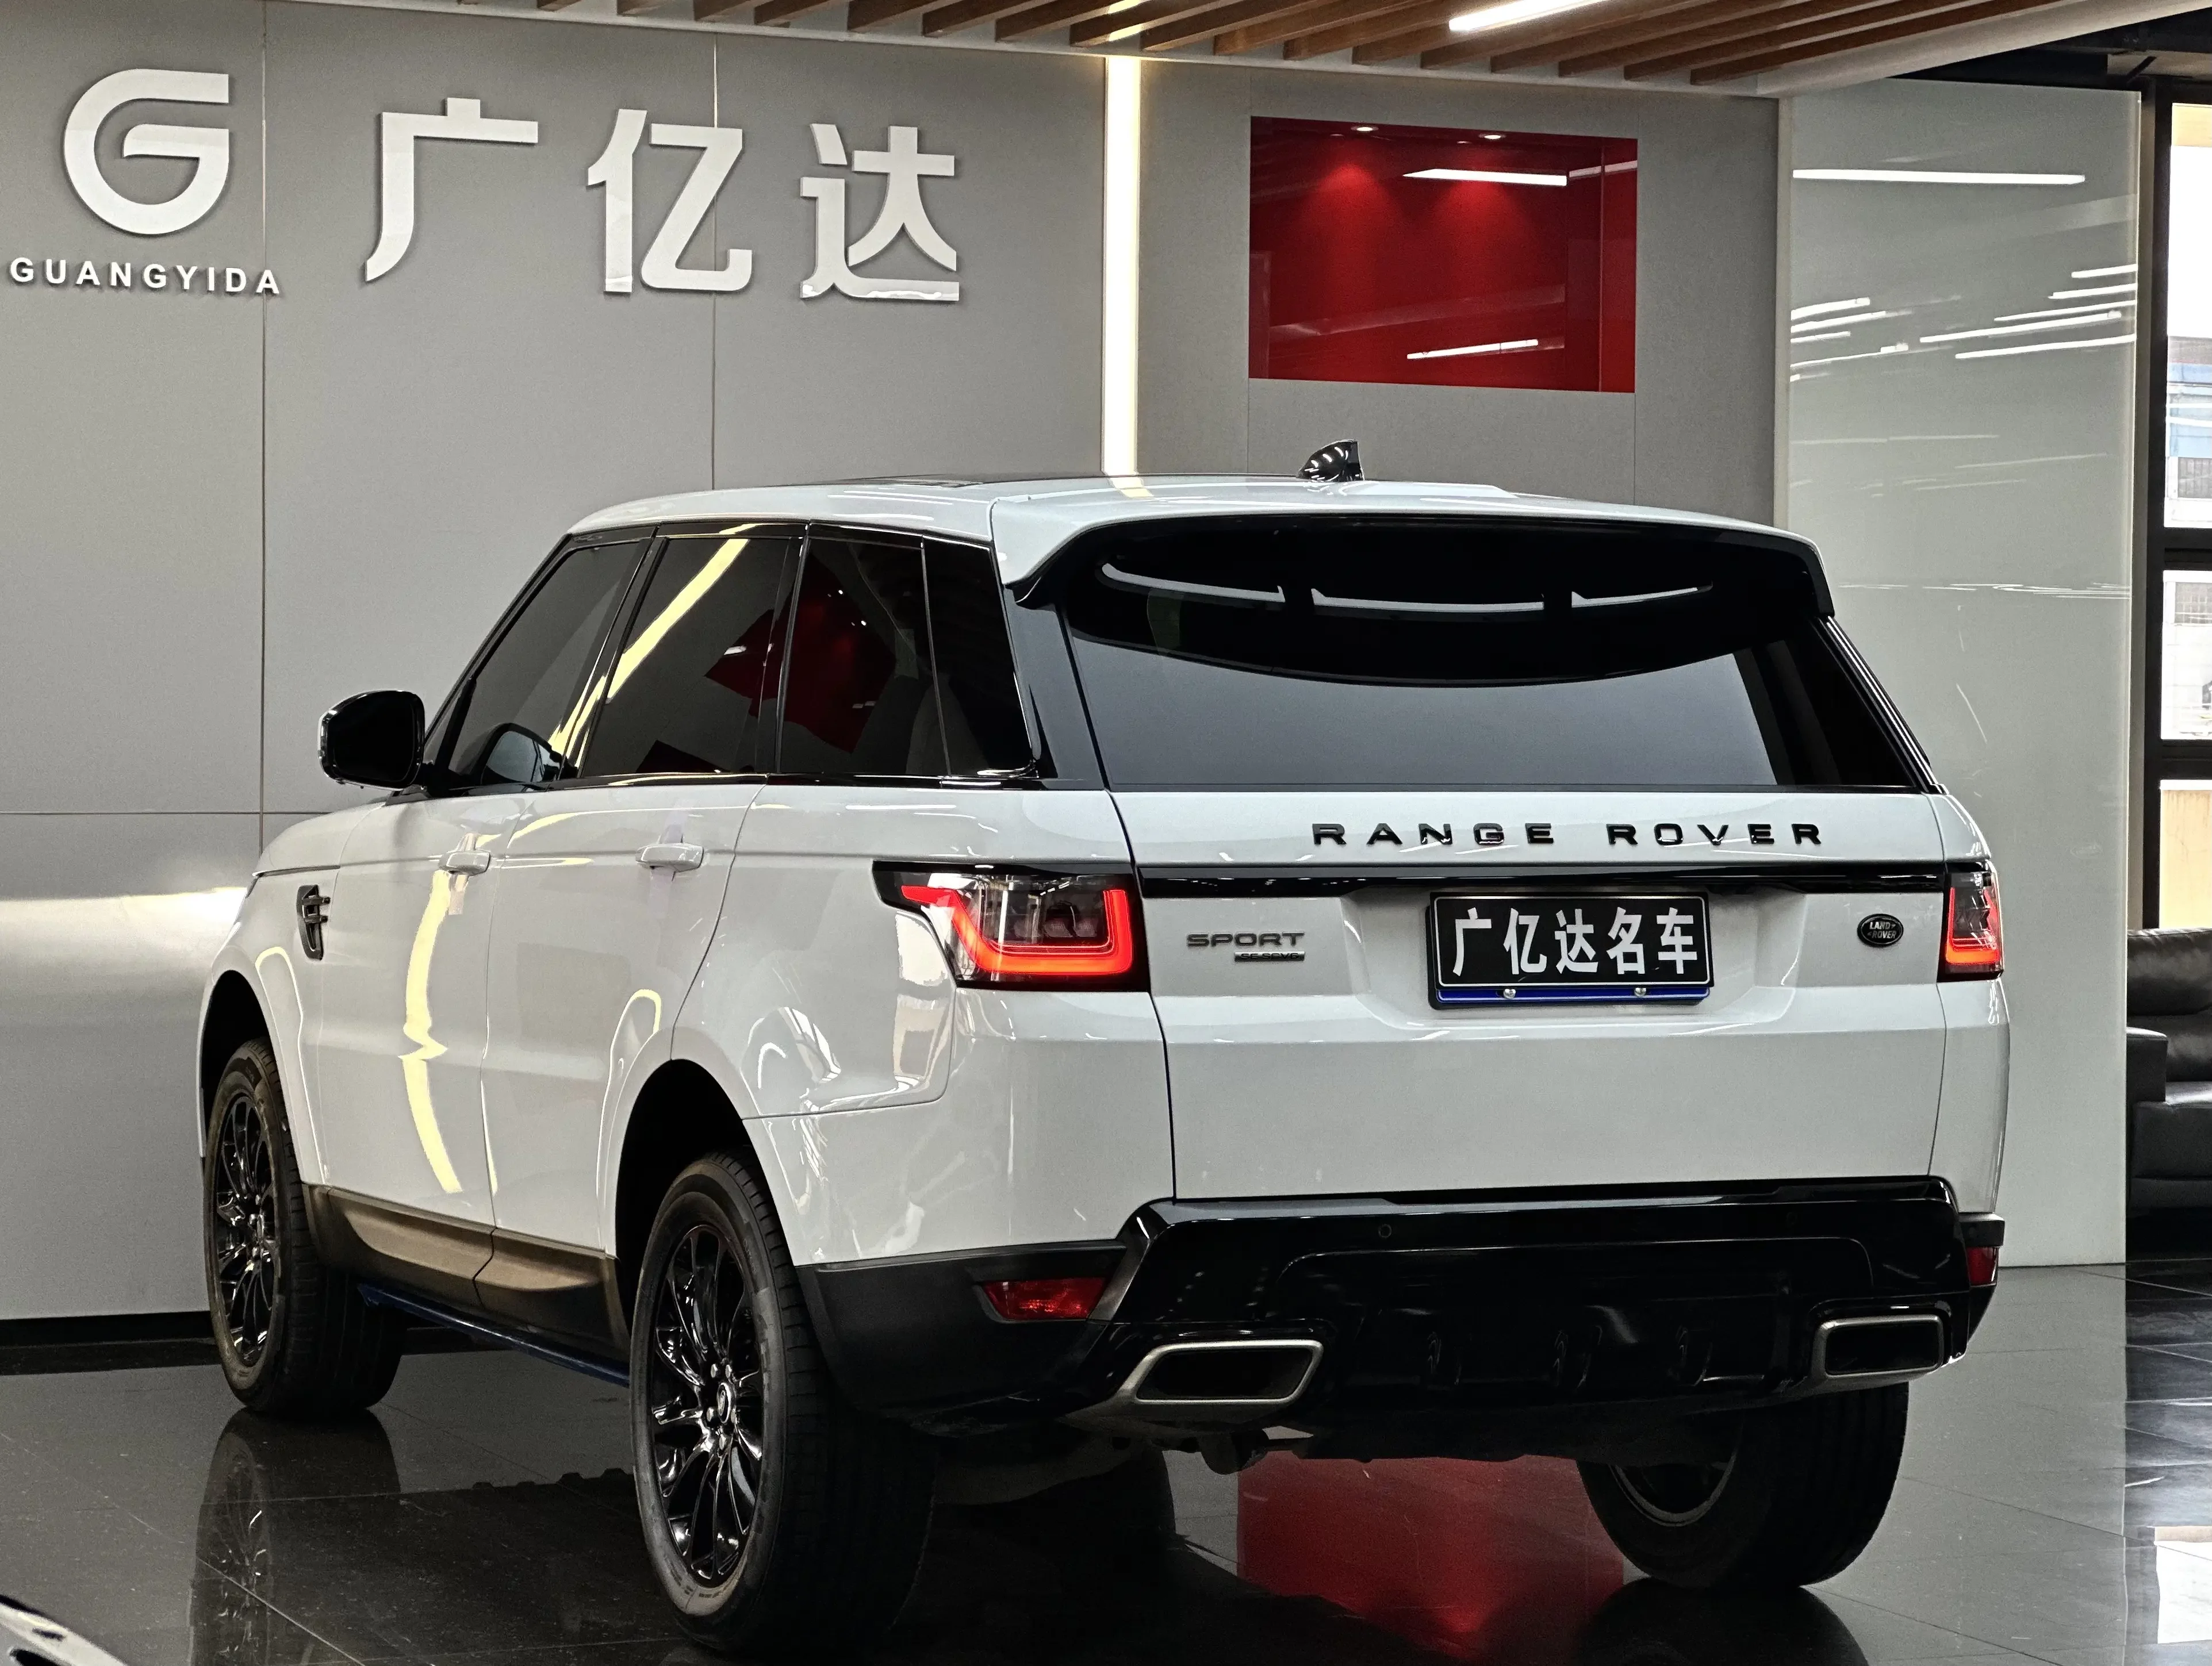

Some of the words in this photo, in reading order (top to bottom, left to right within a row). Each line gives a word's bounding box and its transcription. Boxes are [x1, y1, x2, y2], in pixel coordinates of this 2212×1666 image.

[365, 97, 960, 301] 广亿达
[10, 257, 280, 294] GUANGYIDA
[1312, 823, 1554, 846] RANGE
[1606, 823, 1822, 846] ROVER
[1869, 921, 1891, 930] LAND
[1872, 930, 1896, 939] ROVER
[1186, 931, 1305, 947] SPORT
[1452, 906, 1697, 977] 广亿达名车
